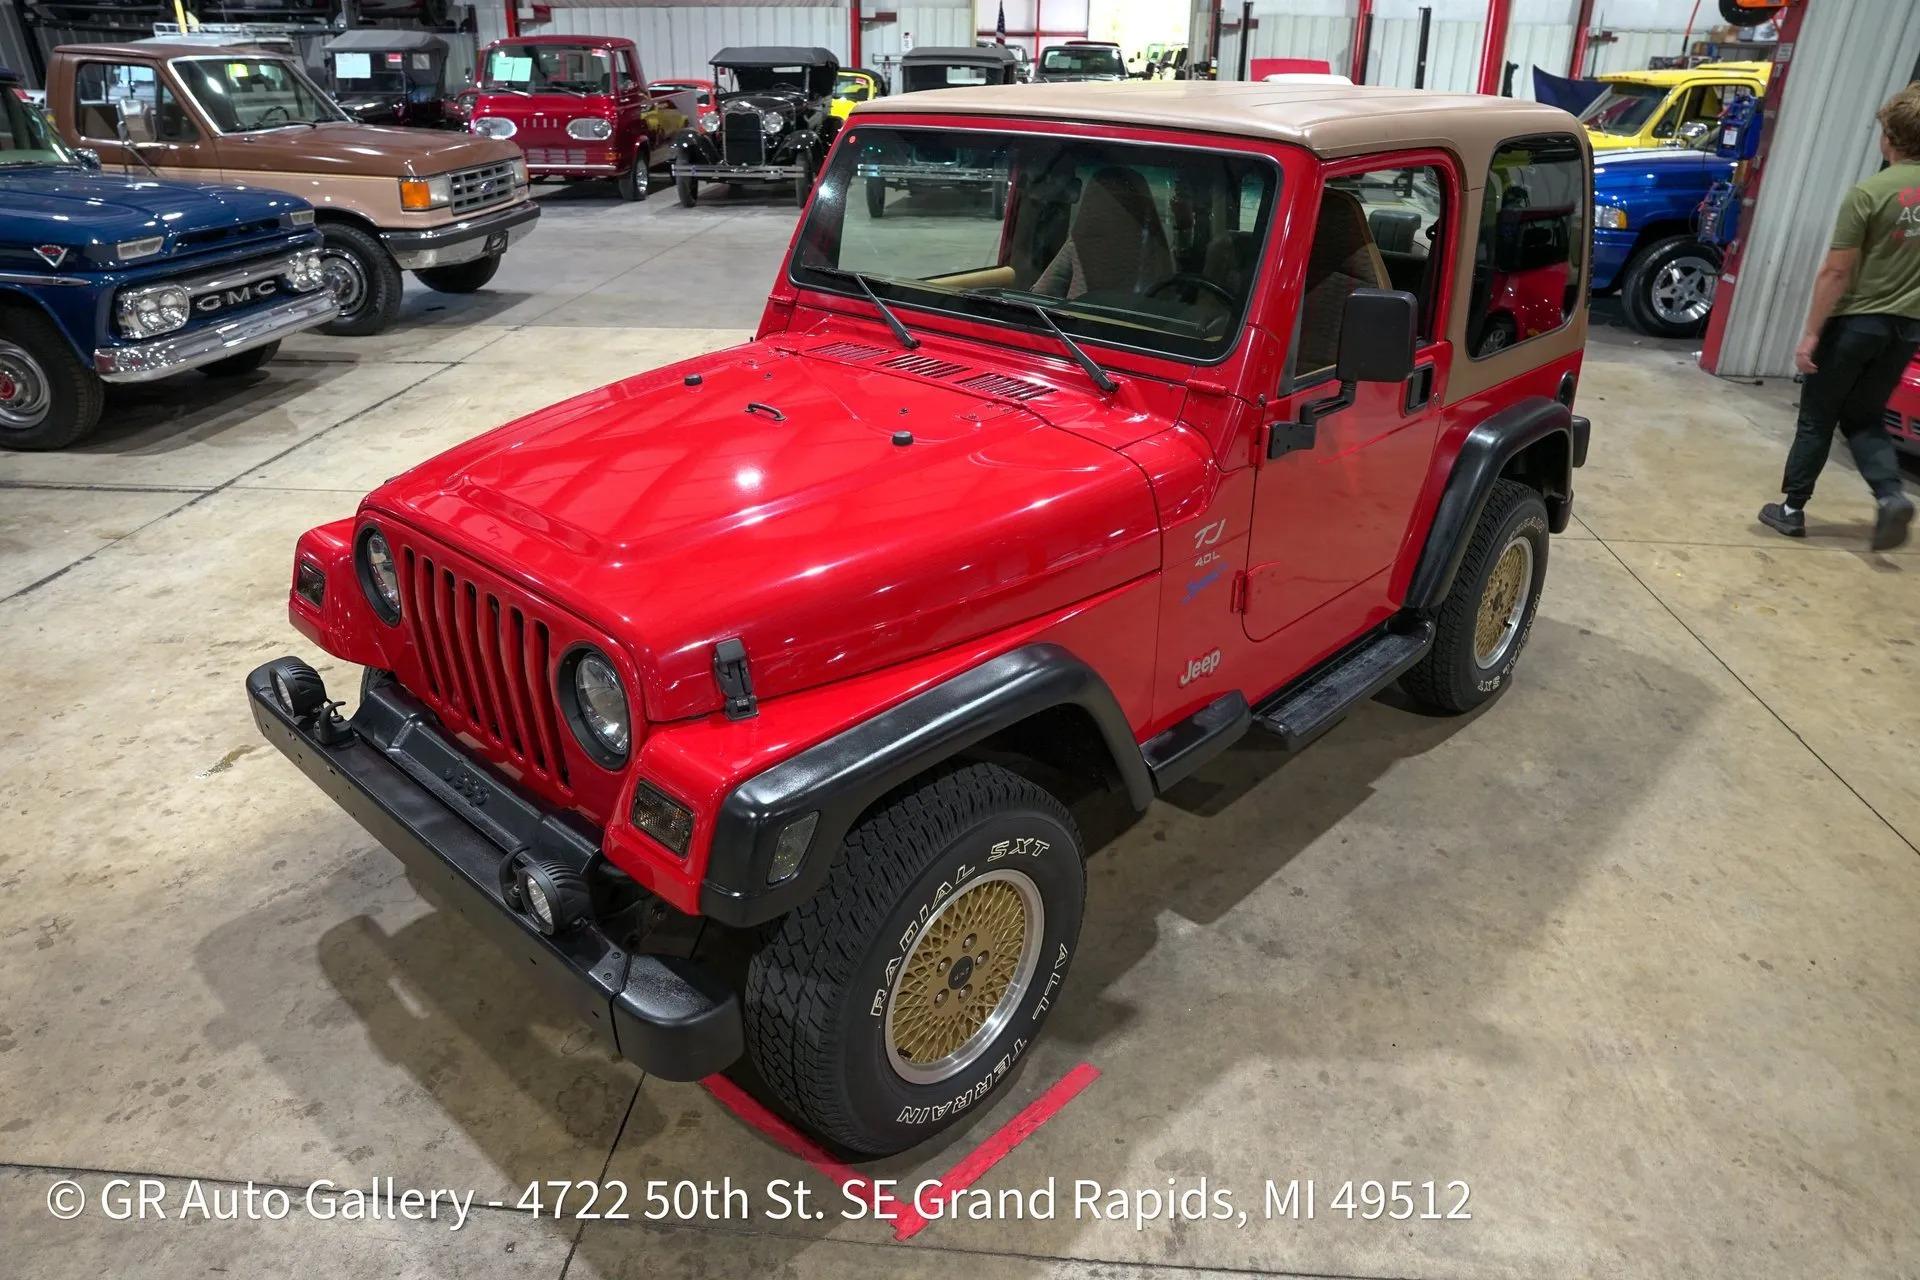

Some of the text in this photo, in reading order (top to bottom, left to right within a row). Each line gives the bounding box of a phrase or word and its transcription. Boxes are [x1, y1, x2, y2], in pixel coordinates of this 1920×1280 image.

[196, 280, 277, 311] GMC
[1194, 518, 1226, 549] TJ
[1179, 648, 1222, 687] Jeep
[870, 837, 1050, 1017] RADIAL SXT
[896, 943, 1068, 1124] ALL TERRAIN
